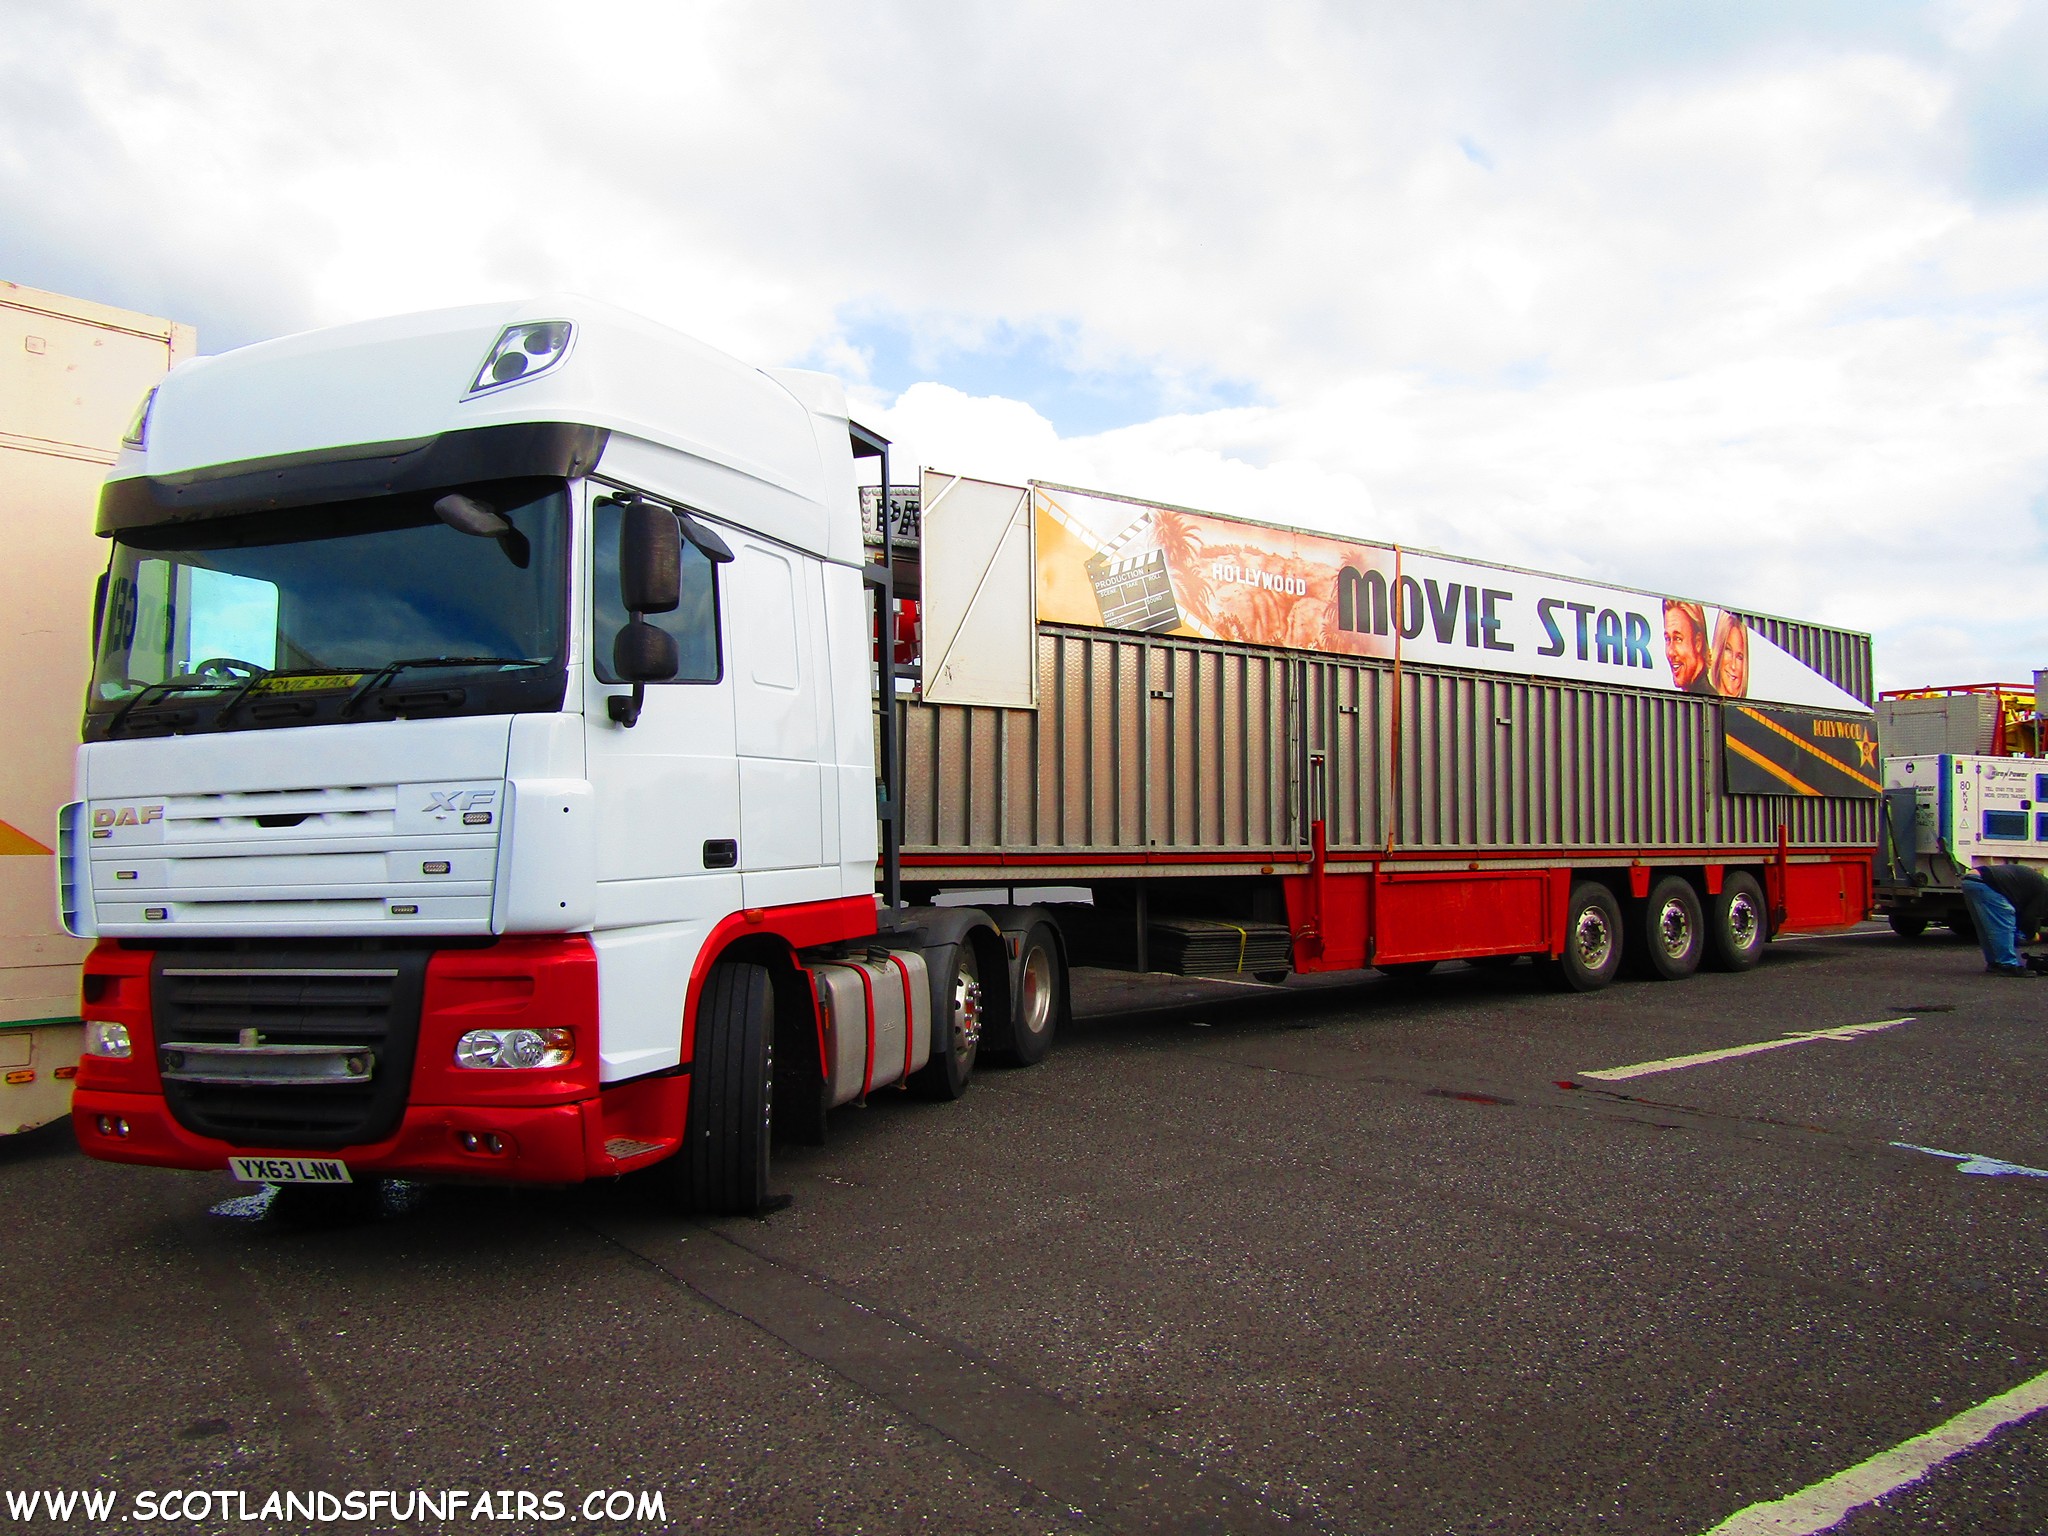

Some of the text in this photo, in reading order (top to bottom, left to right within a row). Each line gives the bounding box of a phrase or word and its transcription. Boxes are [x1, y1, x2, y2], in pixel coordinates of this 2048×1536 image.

[1095, 568, 1145, 590] PRODUCTION
[1212, 563, 1306, 596] HOLLYWOOD
[1147, 595, 1163, 605] SOUND
[1338, 566, 1653, 670] MOVIE STAR
[1813, 719, 1862, 740] HOLLYWOOD
[1960, 780, 1971, 791] 80
[421, 789, 496, 813] XF
[93, 805, 164, 827] DAF
[238, 1159, 343, 1180] YX63 LNW
